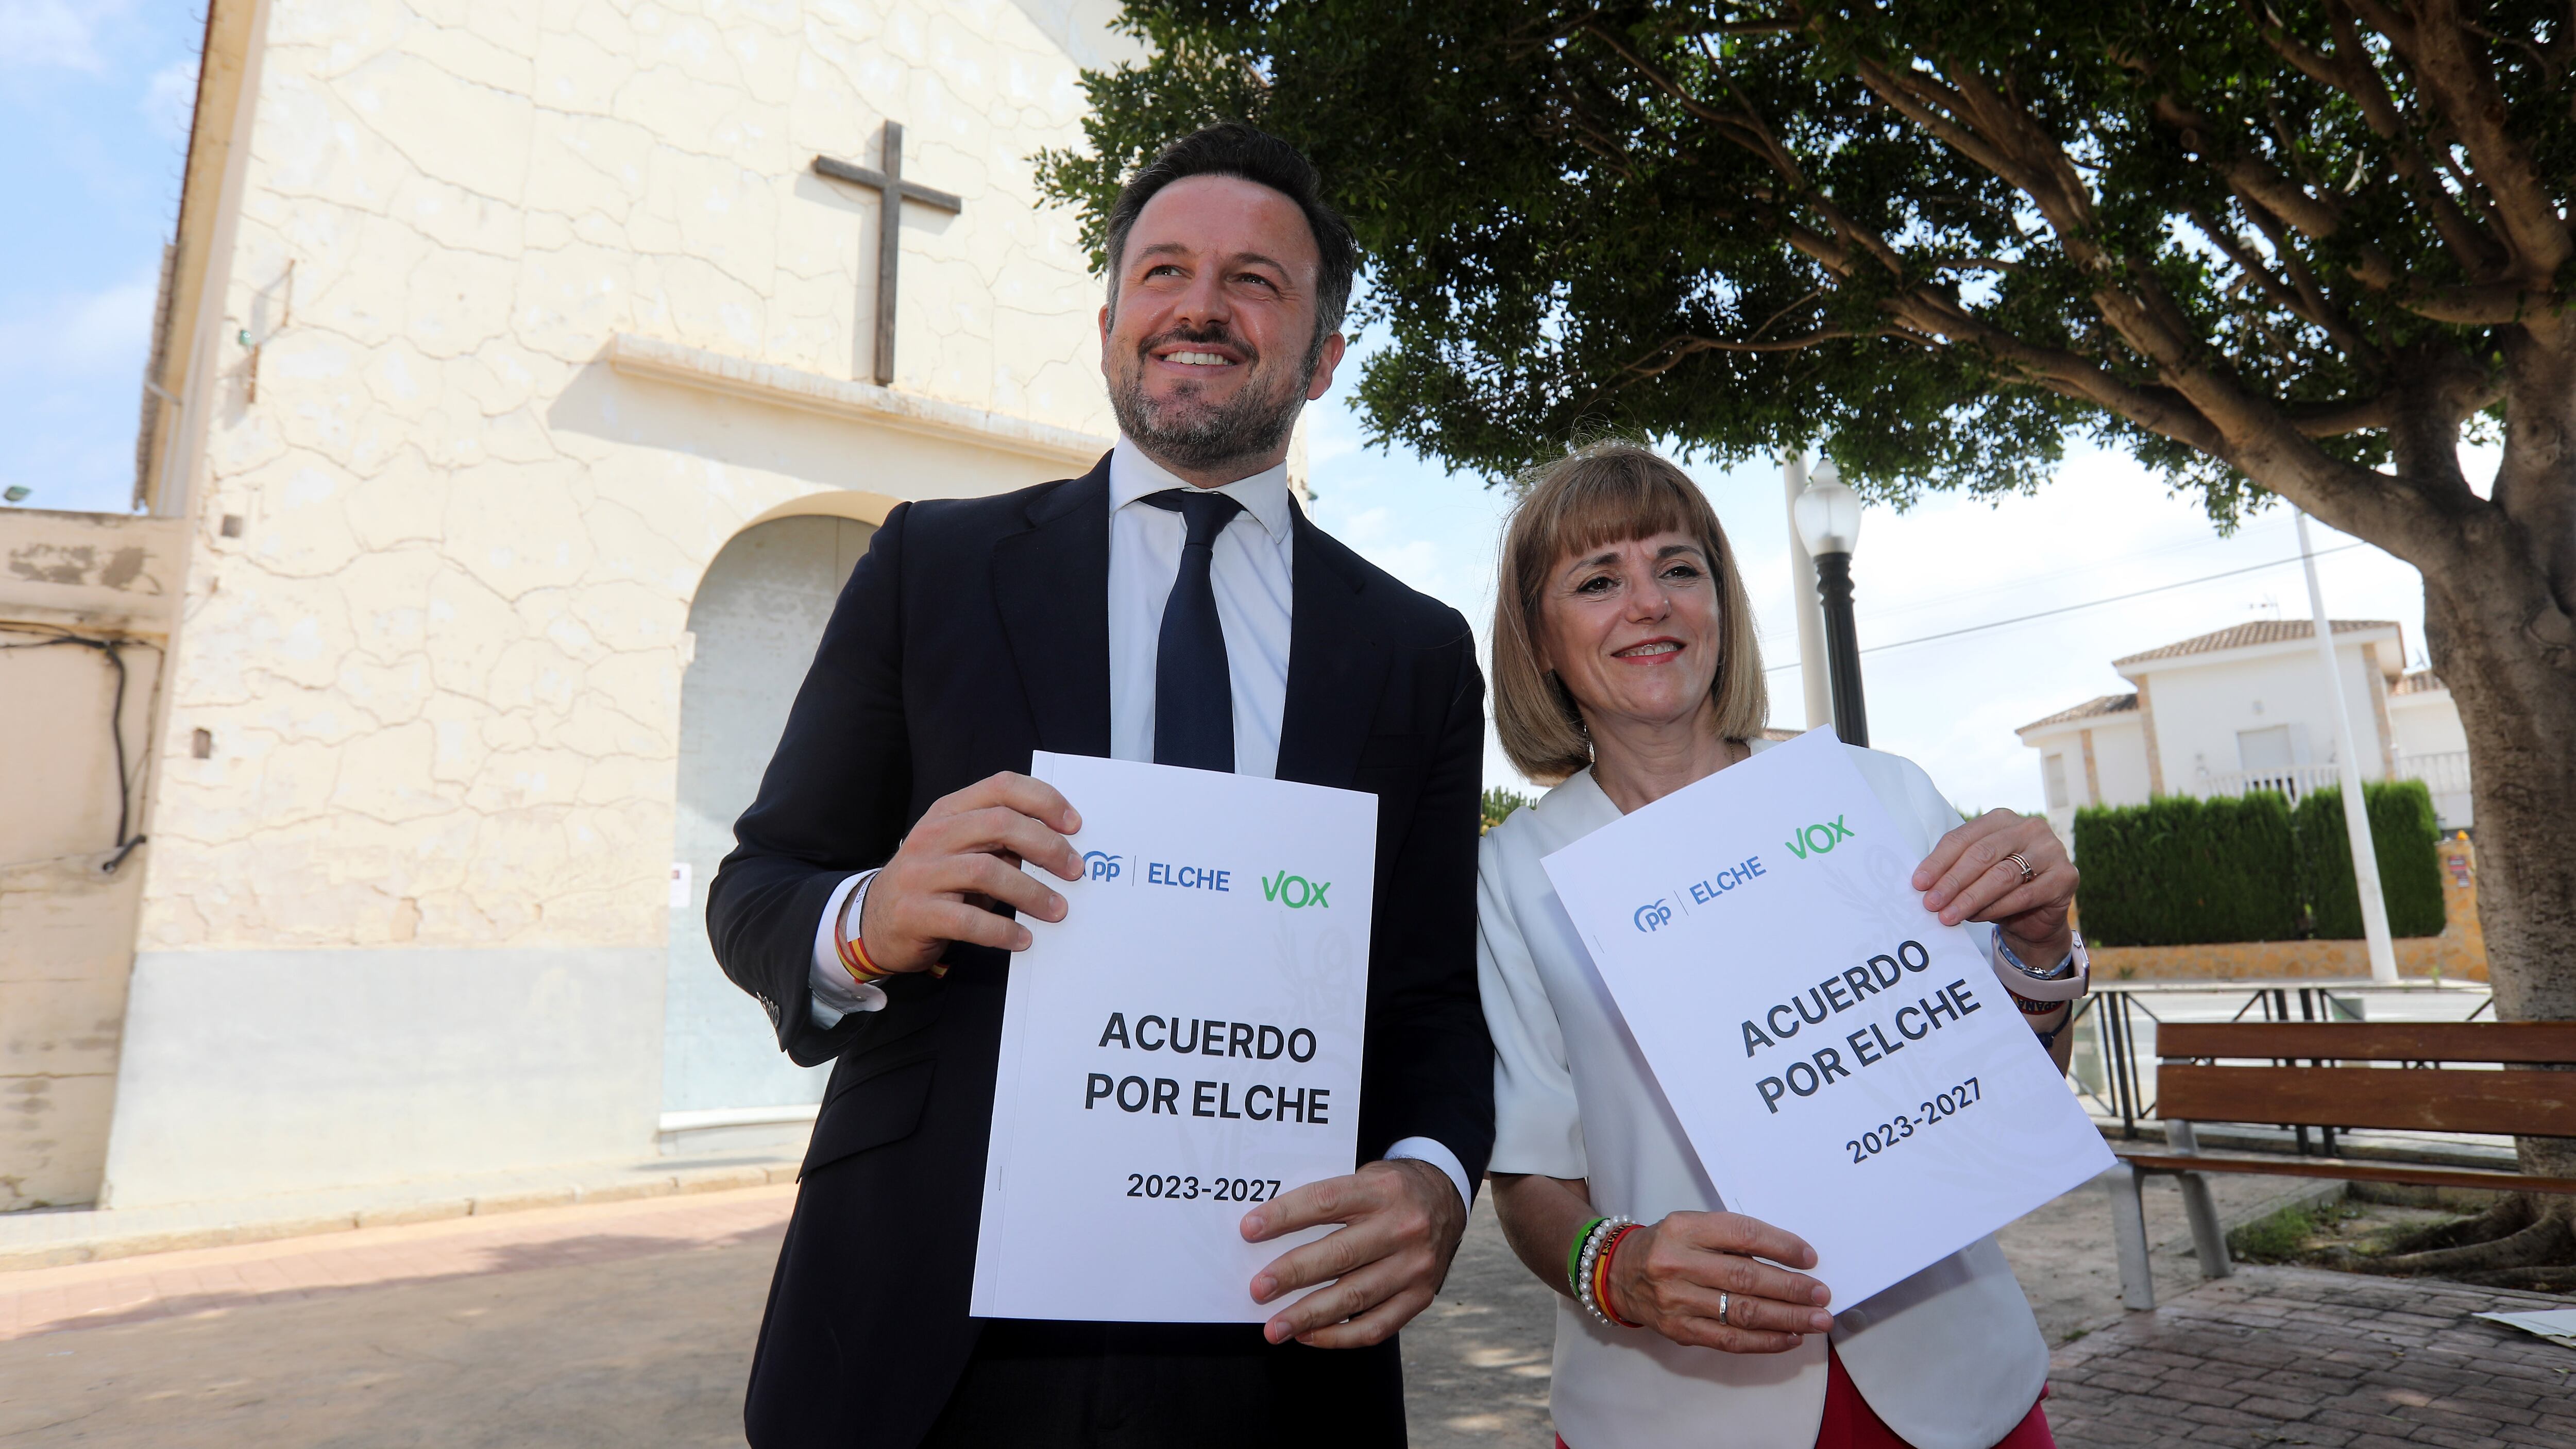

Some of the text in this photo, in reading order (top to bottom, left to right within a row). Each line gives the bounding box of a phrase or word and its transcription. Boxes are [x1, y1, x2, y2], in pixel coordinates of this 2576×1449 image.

[1785, 814, 1855, 860] VOX
[1148, 862, 1230, 892] ELCHE
[1262, 871, 1330, 909] VOX
[1689, 856, 1767, 905] ELCHE
[1740, 940, 1930, 1058] ACUERDO
[1098, 1012, 1316, 1063] ACUERDO
[1754, 1046, 1851, 1114] POR
[1846, 978, 1982, 1067] ELCHE
[1085, 1073, 1330, 1124] POR ELCHE
[1845, 1077, 1982, 1164] 2023-2027
[1127, 1173, 1281, 1202] 2023-2027
